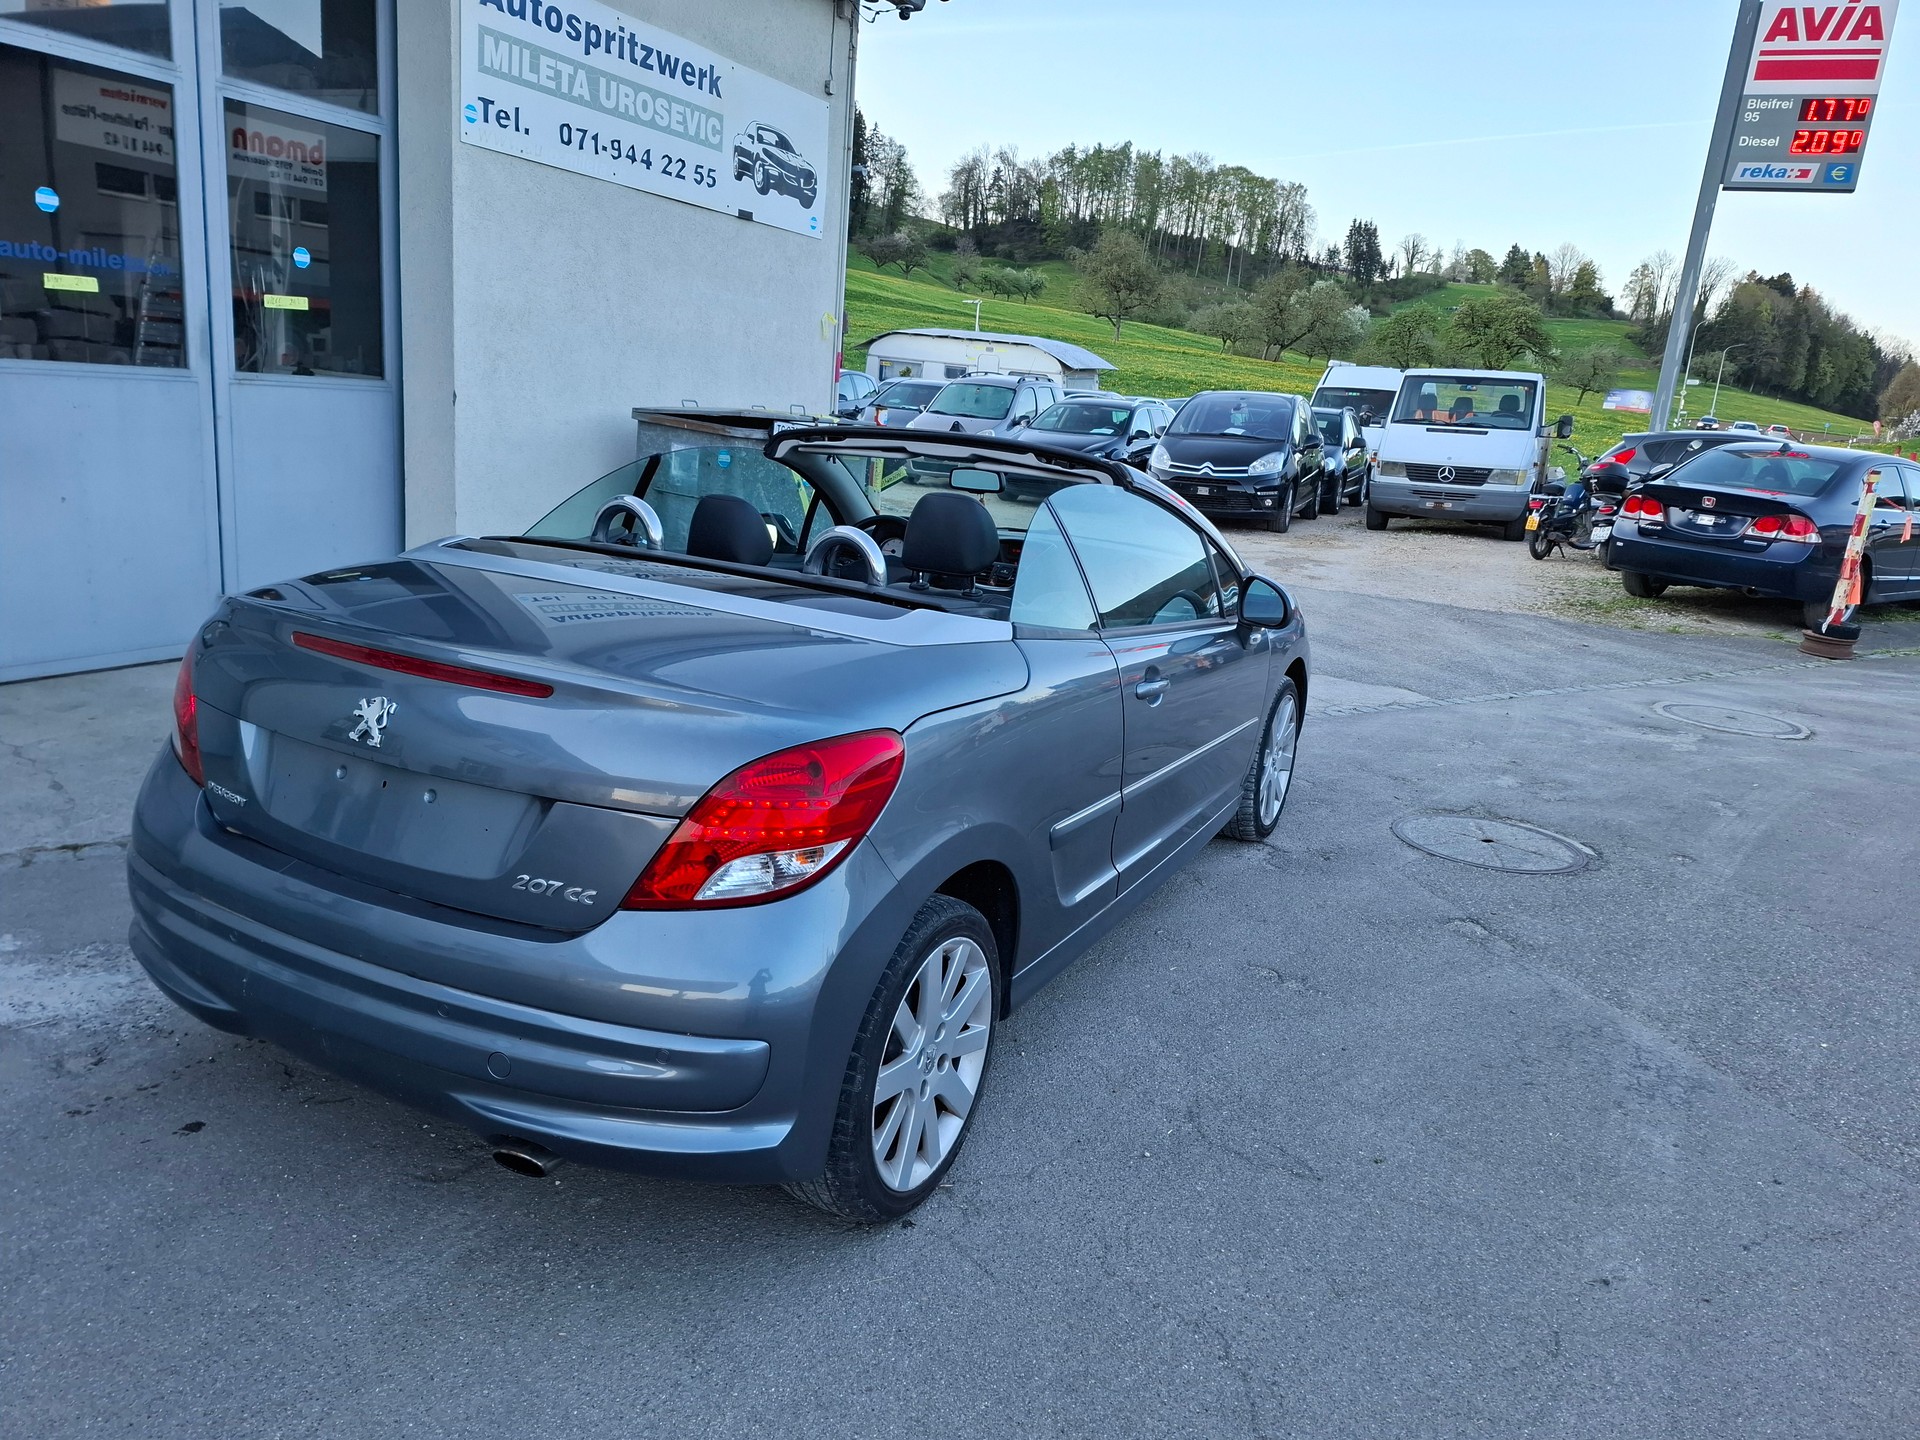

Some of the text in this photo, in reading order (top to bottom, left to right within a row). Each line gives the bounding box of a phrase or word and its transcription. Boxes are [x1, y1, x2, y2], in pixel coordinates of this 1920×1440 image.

[1762, 0, 1884, 42] AVIA
[478, 0, 722, 99] utospritzwerk
[483, 34, 721, 145] MILETA UROSEVIC
[1746, 98, 1794, 109] Bleifrei
[1743, 111, 1760, 122] 95
[478, 97, 529, 135] Tel.
[559, 123, 652, 170] 071-944
[661, 154, 687, 180] 22
[694, 164, 717, 188] 55
[1738, 136, 1780, 147] Diesel
[512, 874, 598, 906] 207 CC
